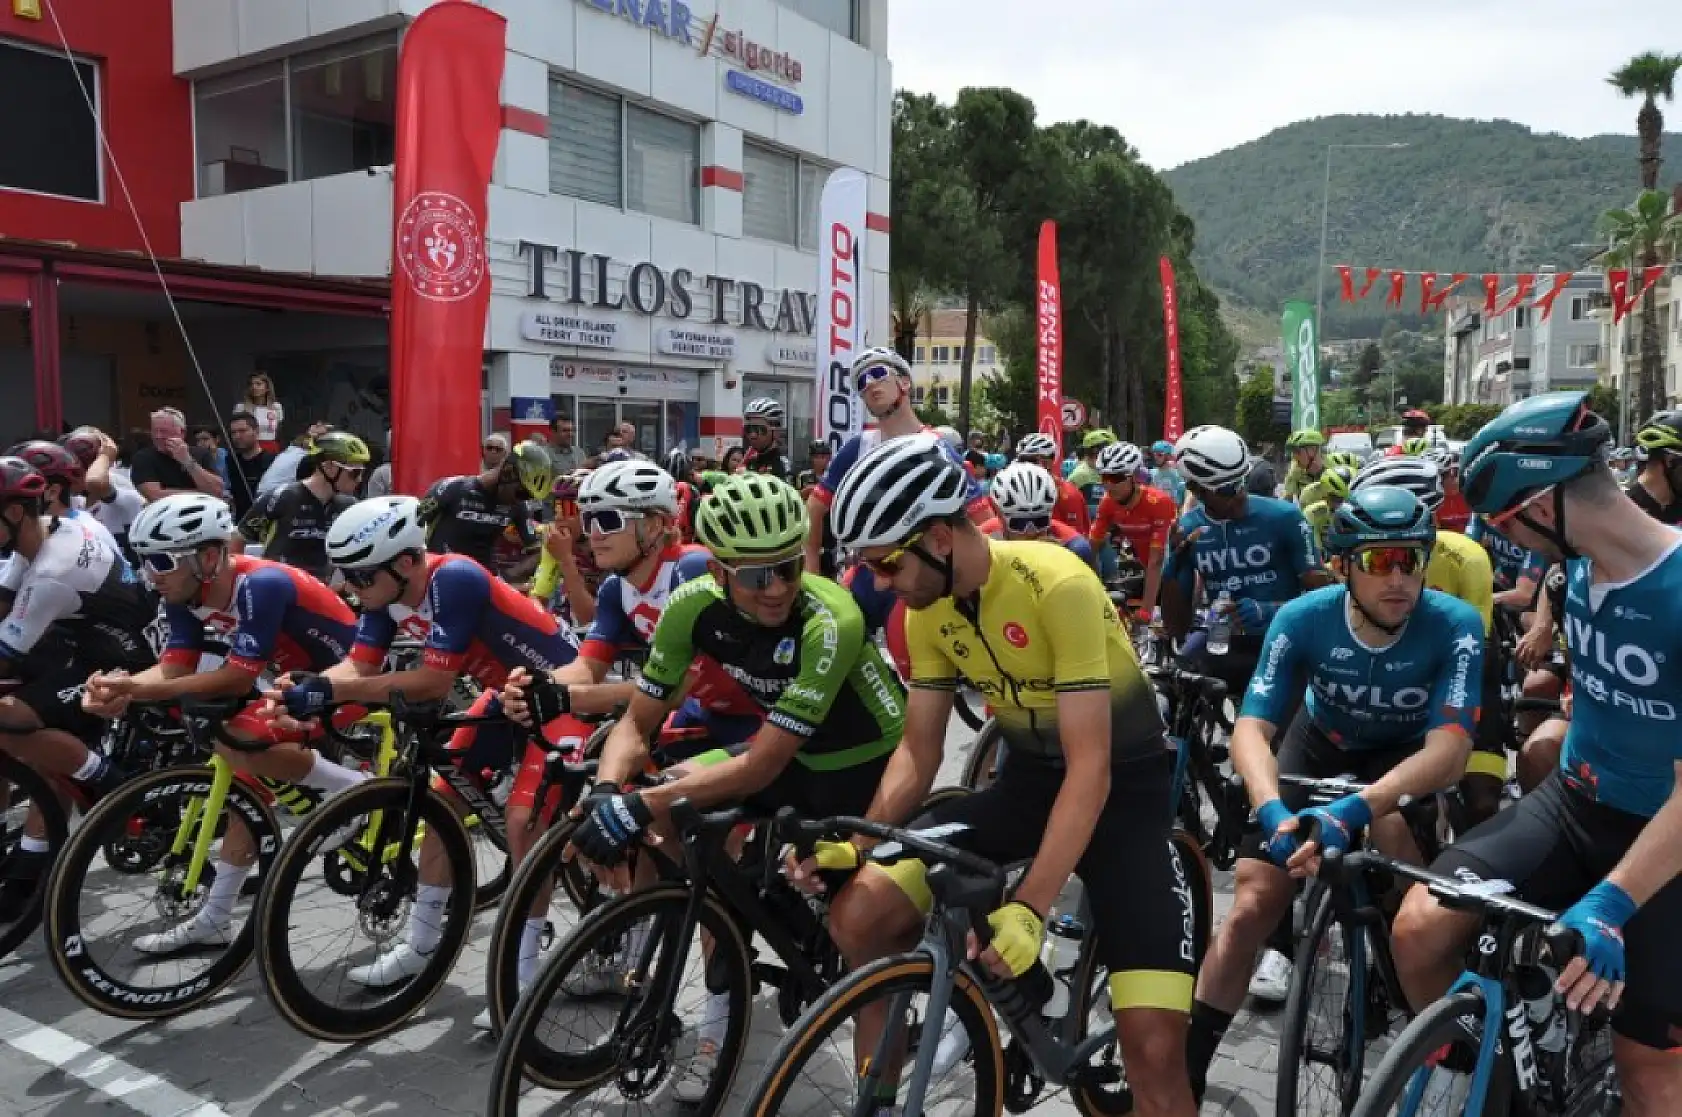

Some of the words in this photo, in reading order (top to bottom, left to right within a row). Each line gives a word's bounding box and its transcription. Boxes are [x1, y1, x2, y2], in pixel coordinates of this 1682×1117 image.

[724, 29, 801, 82] sigorta
[519, 239, 692, 318] TILOS
[830, 222, 853, 356] TOTO
[541, 328, 571, 340] FERRY
[578, 332, 612, 345] TICKET
[1196, 544, 1271, 573] HYLO
[1313, 675, 1430, 709] HYLO
[1612, 689, 1677, 721] AID
[81, 967, 212, 1005] REYNOLDS
